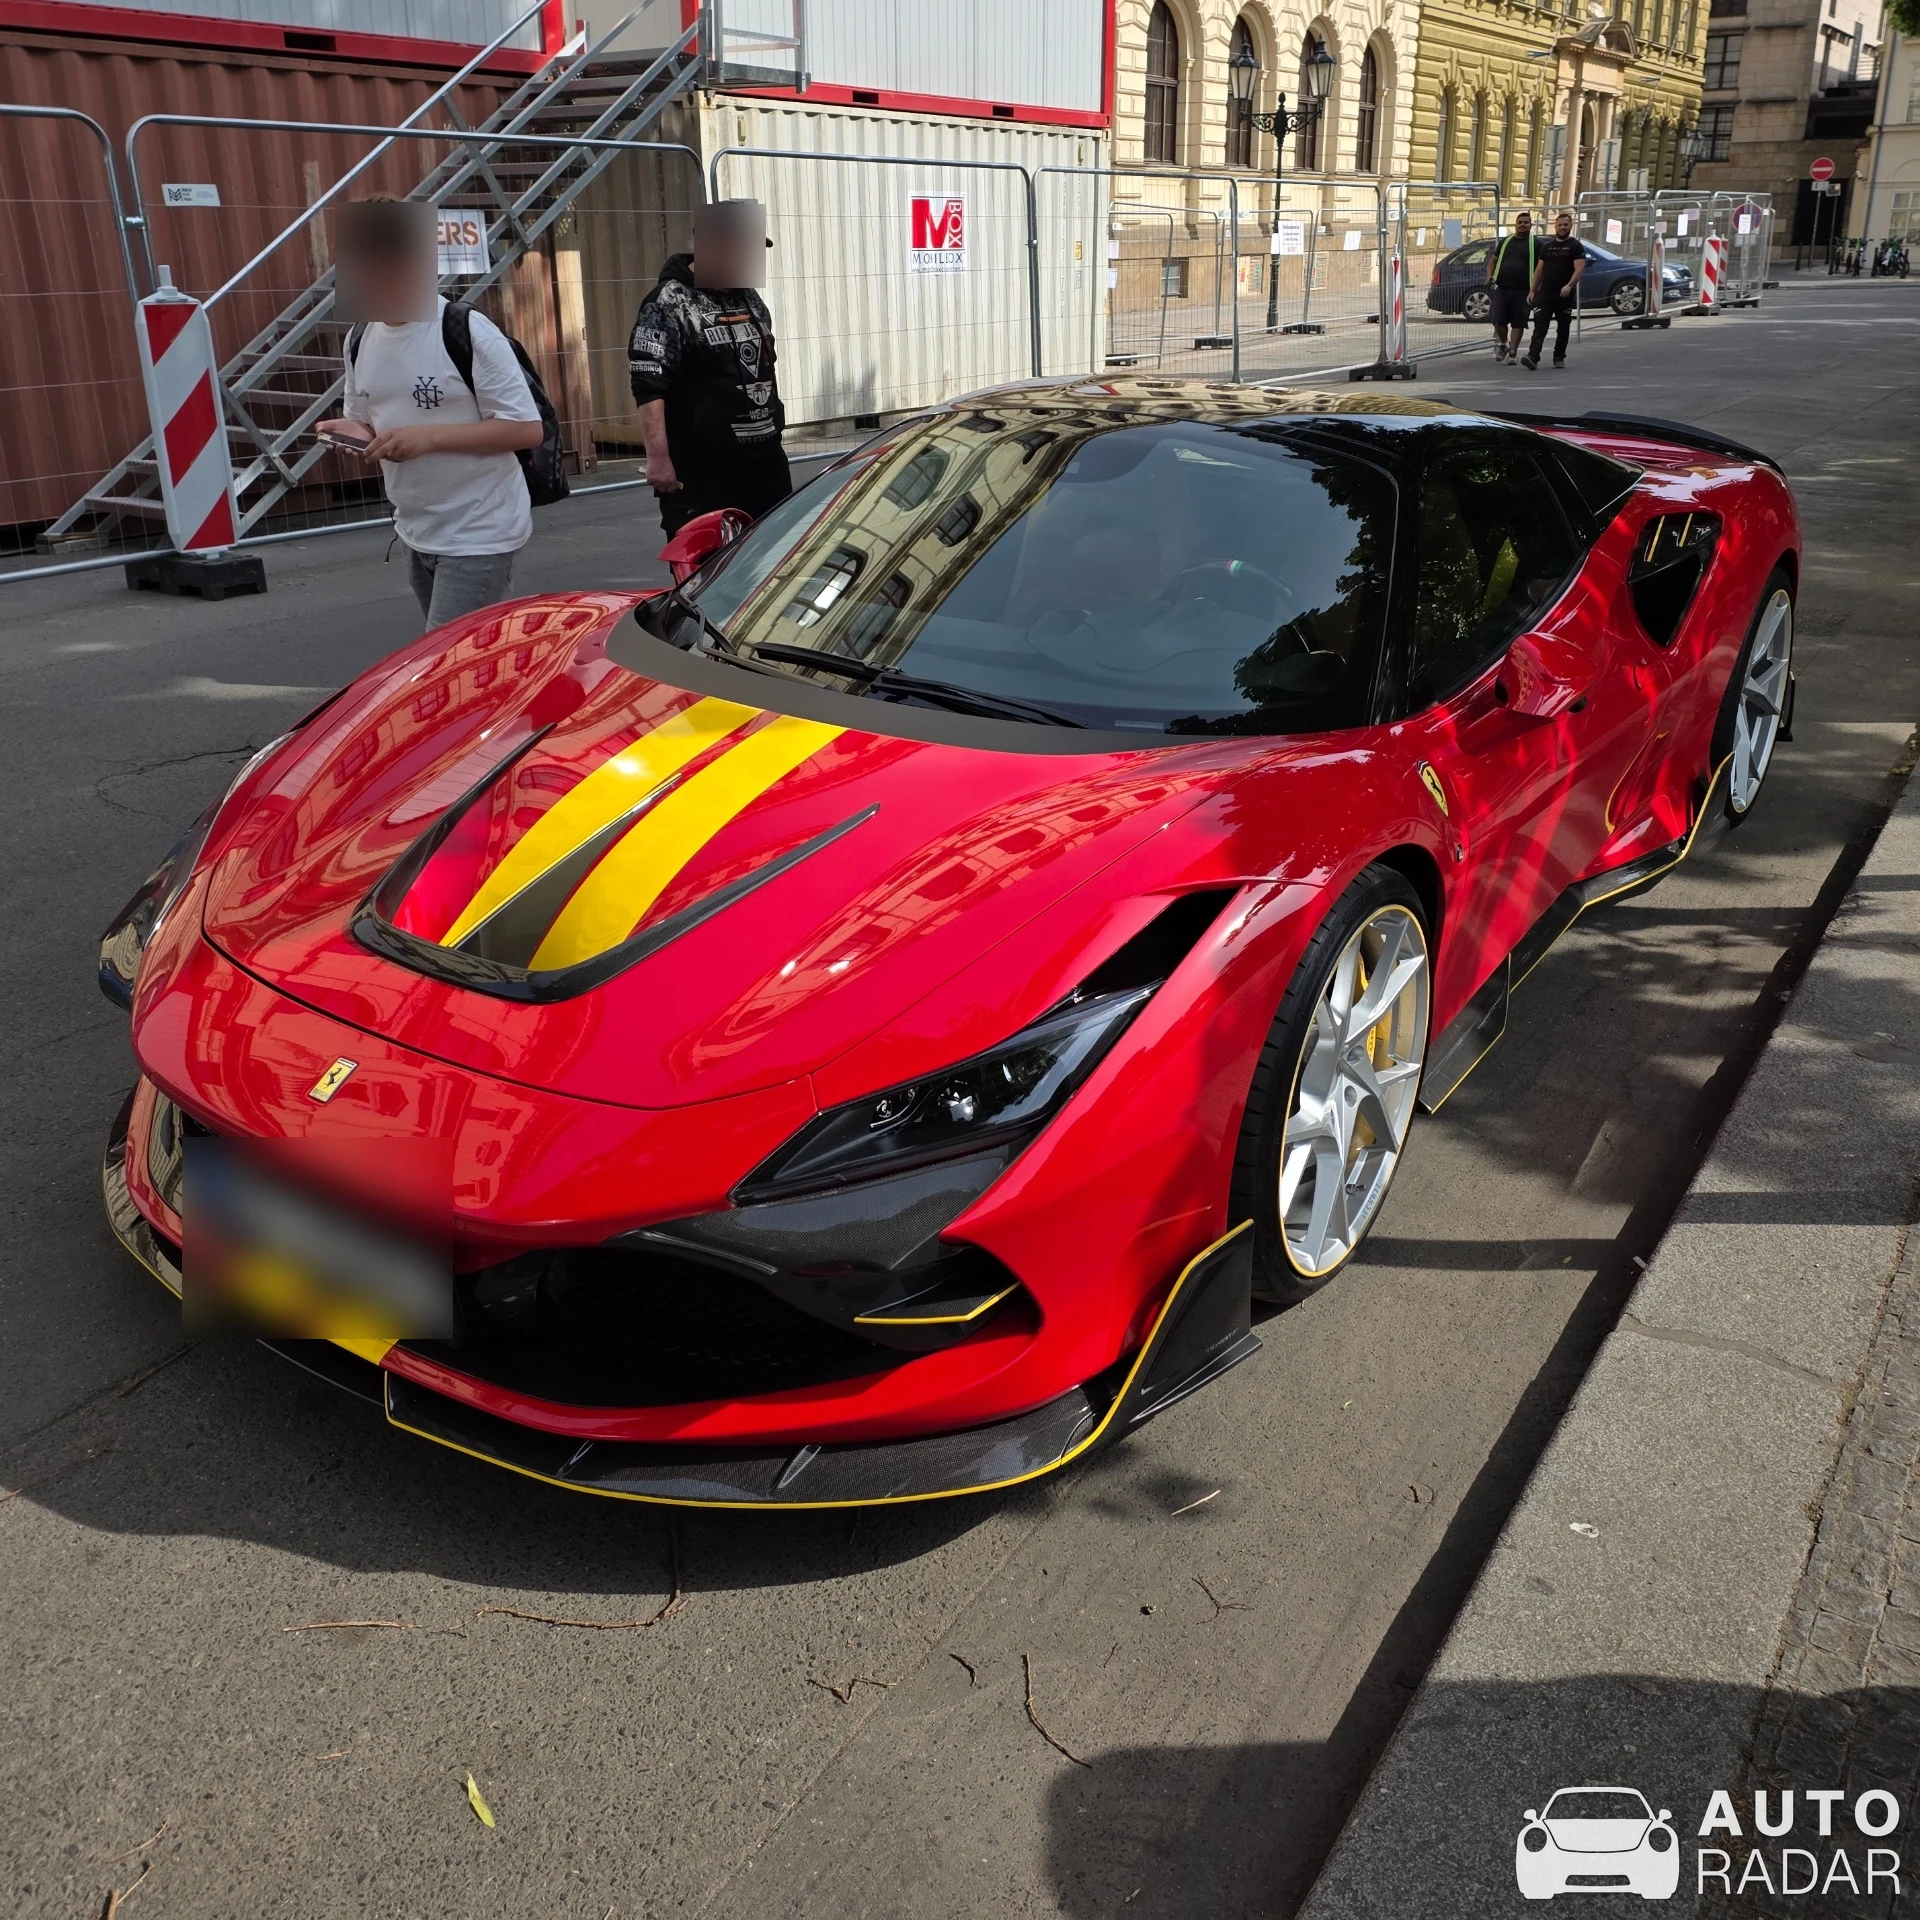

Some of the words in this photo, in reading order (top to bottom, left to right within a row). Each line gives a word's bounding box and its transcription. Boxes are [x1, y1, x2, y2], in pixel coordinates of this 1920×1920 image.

[438, 221, 479, 246] ERS
[949, 202, 962, 246] BOX
[635, 326, 668, 344] BLACK
[749, 407, 769, 420] WEAR
